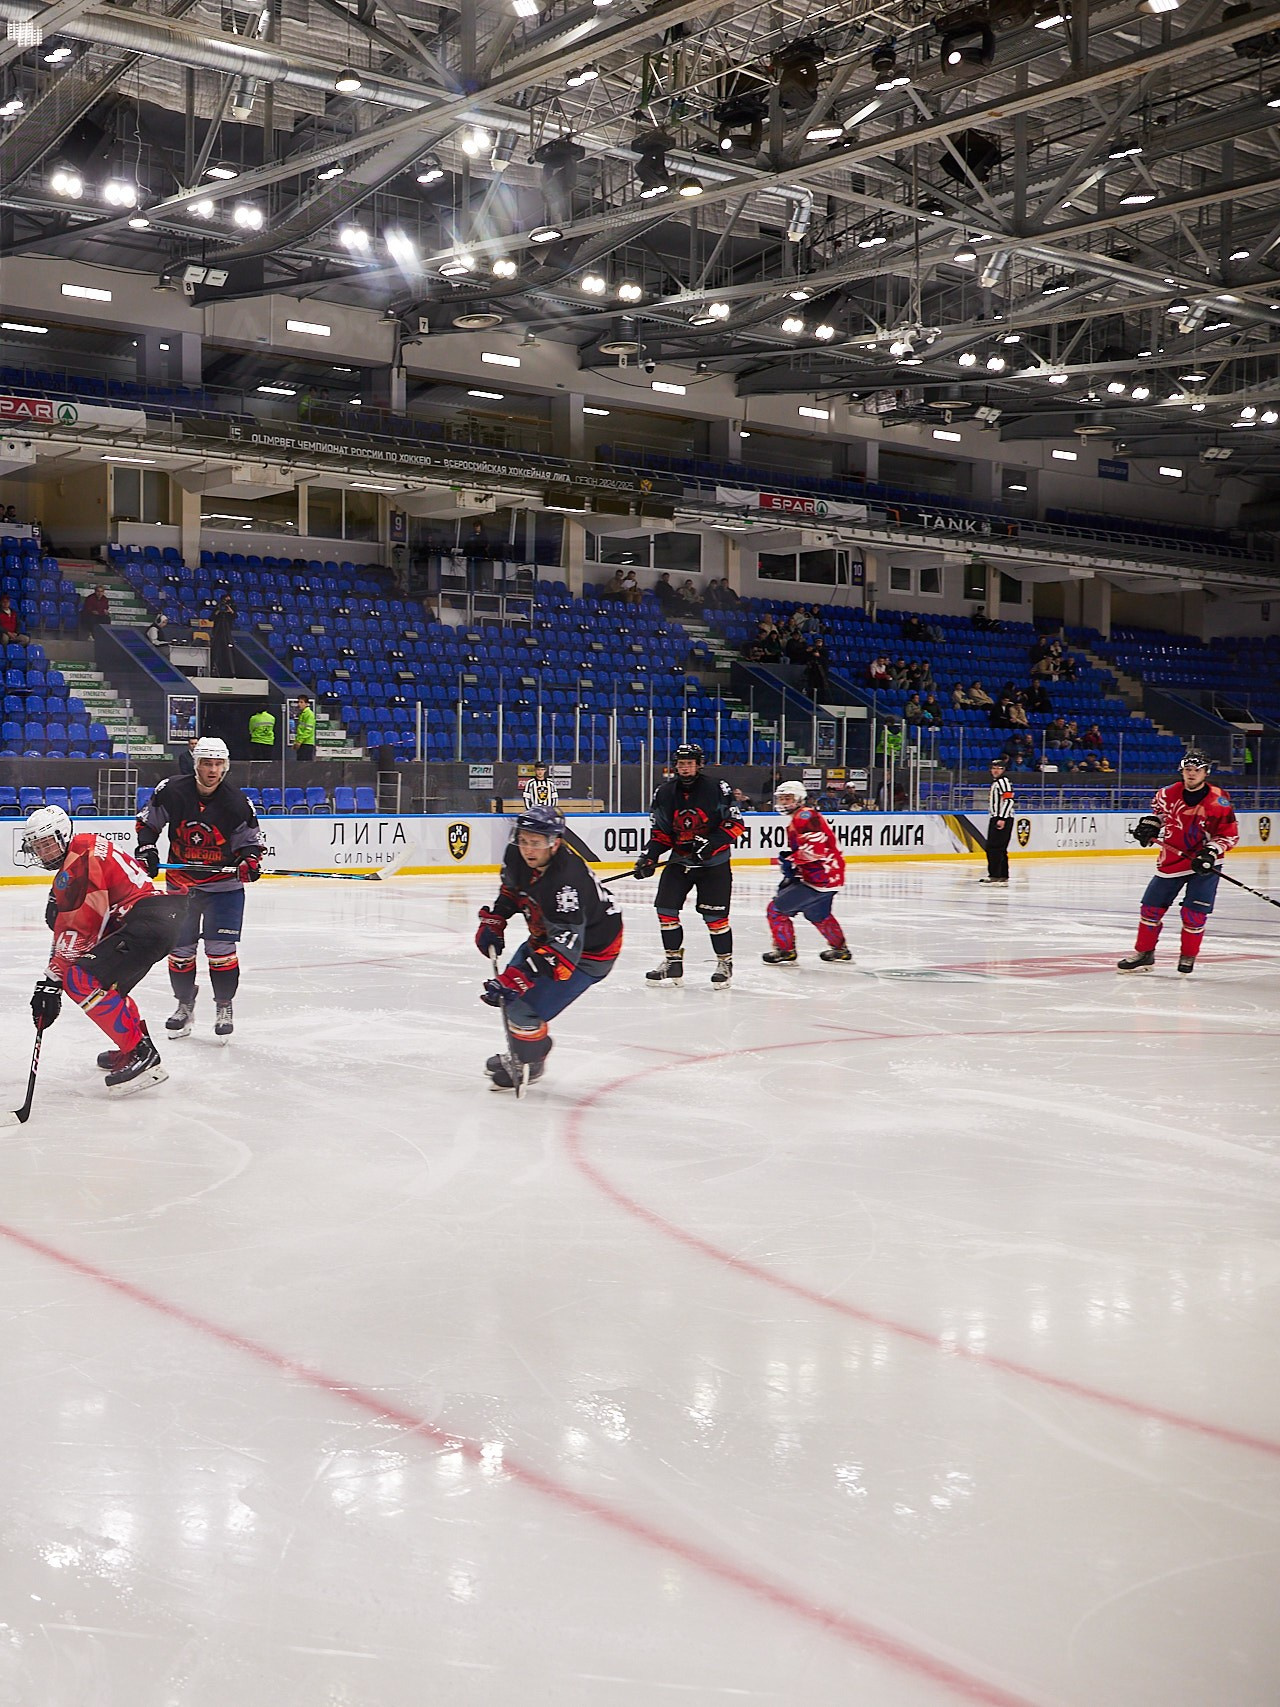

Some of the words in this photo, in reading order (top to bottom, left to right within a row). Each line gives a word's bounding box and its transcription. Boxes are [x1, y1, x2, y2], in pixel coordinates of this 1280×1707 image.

[186, 281, 192, 291] 8
[421, 321, 427, 330] 7
[251, 433, 296, 448] OLIMPBET
[297, 440, 349, 455] ЧЕМПИОНАТ
[350, 447, 384, 459] РОССИИ
[385, 451, 398, 461] ПО
[399, 453, 432, 465] ХОККЕЮ
[443, 459, 507, 474] ВСЕРОССИЙСКАЯ
[508, 466, 551, 480] ХОККЕЙНАЯ
[553, 473, 571, 482] ЛИГА
[771, 497, 816, 513] SPAR
[32, 526, 40, 536] 5
[394, 516, 402, 531] 9
[918, 513, 978, 534] TANK
[852, 564, 863, 577] 10
[1055, 817, 1098, 834] ЛИГА
[330, 822, 407, 845] ЛИГА
[880, 825, 924, 846] ЛИГА
[1056, 839, 1097, 848] СИЛЬНЫХ
[334, 852, 401, 864] СИЛЬНЫ
[55, 930, 79, 951] 47
